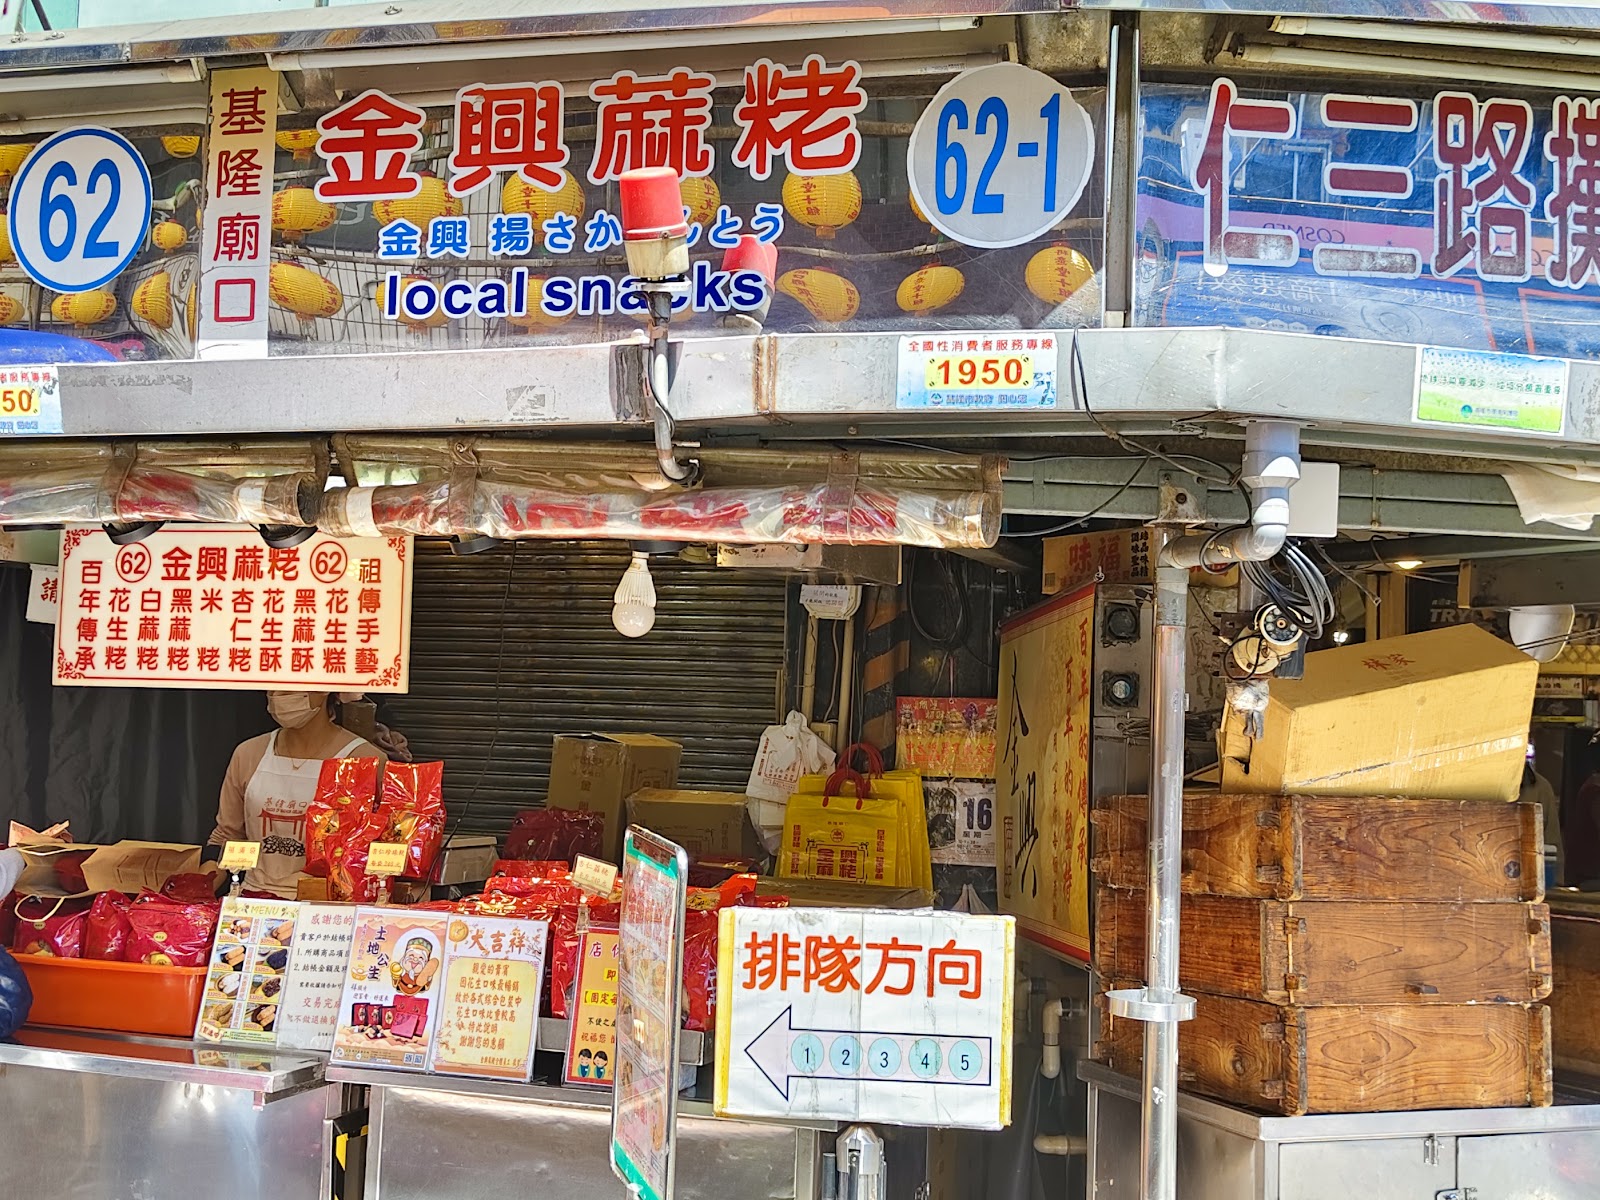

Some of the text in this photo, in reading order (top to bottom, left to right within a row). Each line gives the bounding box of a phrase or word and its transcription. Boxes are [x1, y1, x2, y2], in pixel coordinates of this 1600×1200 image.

[935, 92, 1061, 216] 62-1
[39, 158, 122, 262] 62
[212, 86, 266, 325] 基隆廟口
[380, 203, 784, 257] 金興 揚さかとう
[386, 271, 526, 316] local
[908, 338, 1054, 352] 全國性消費者服務專線
[937, 358, 1023, 386] 1950
[75, 560, 104, 672] 百年傳承
[259, 588, 285, 673] 花生酥
[322, 588, 350, 674] 花生糕
[353, 558, 383, 675] 祖傳手藝
[964, 798, 992, 832] 16
[250, 905, 280, 916] MENU
[468, 929, 527, 954] 大吉祥
[742, 931, 982, 1000] 排隊方向
[841, 1049, 851, 1067] 2
[879, 1051, 890, 1069] 3
[920, 1052, 930, 1070] 4
[960, 1053, 970, 1072] 5
